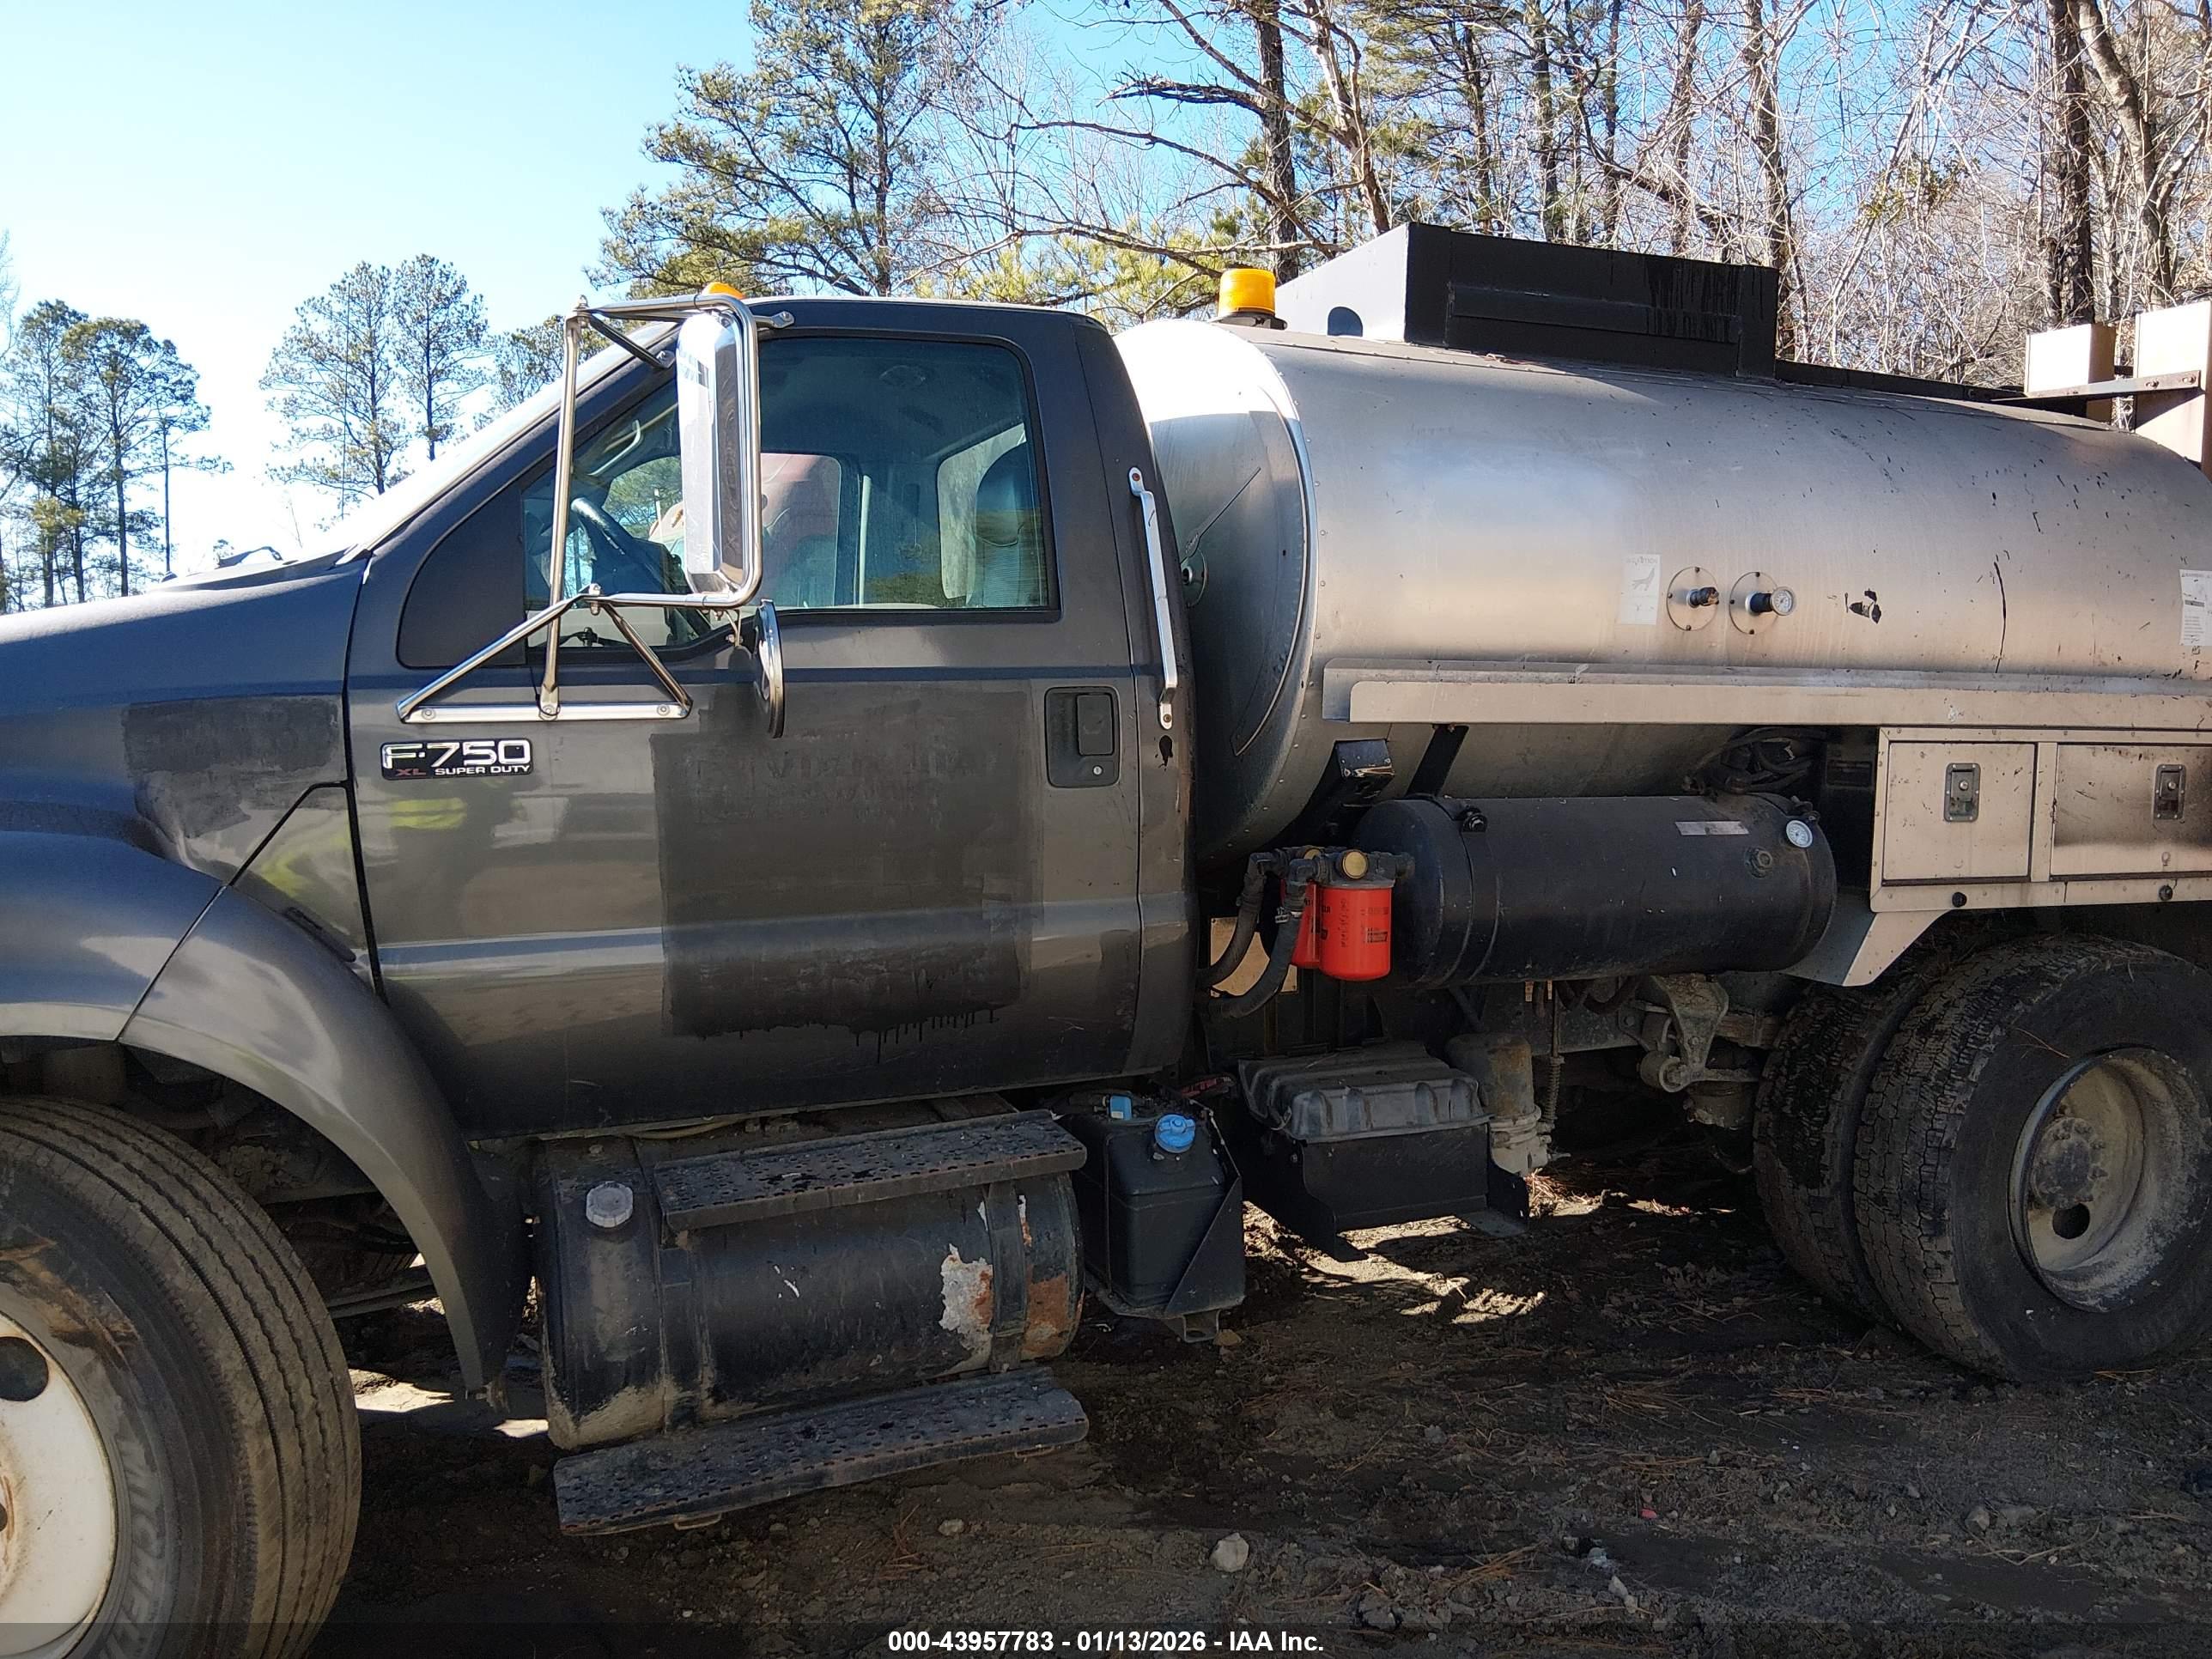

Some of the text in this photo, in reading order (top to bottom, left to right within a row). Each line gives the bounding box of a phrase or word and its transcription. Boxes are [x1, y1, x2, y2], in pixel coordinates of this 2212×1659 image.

[395, 768, 427, 776] XL
[434, 764, 531, 776] SUPER DUTY
